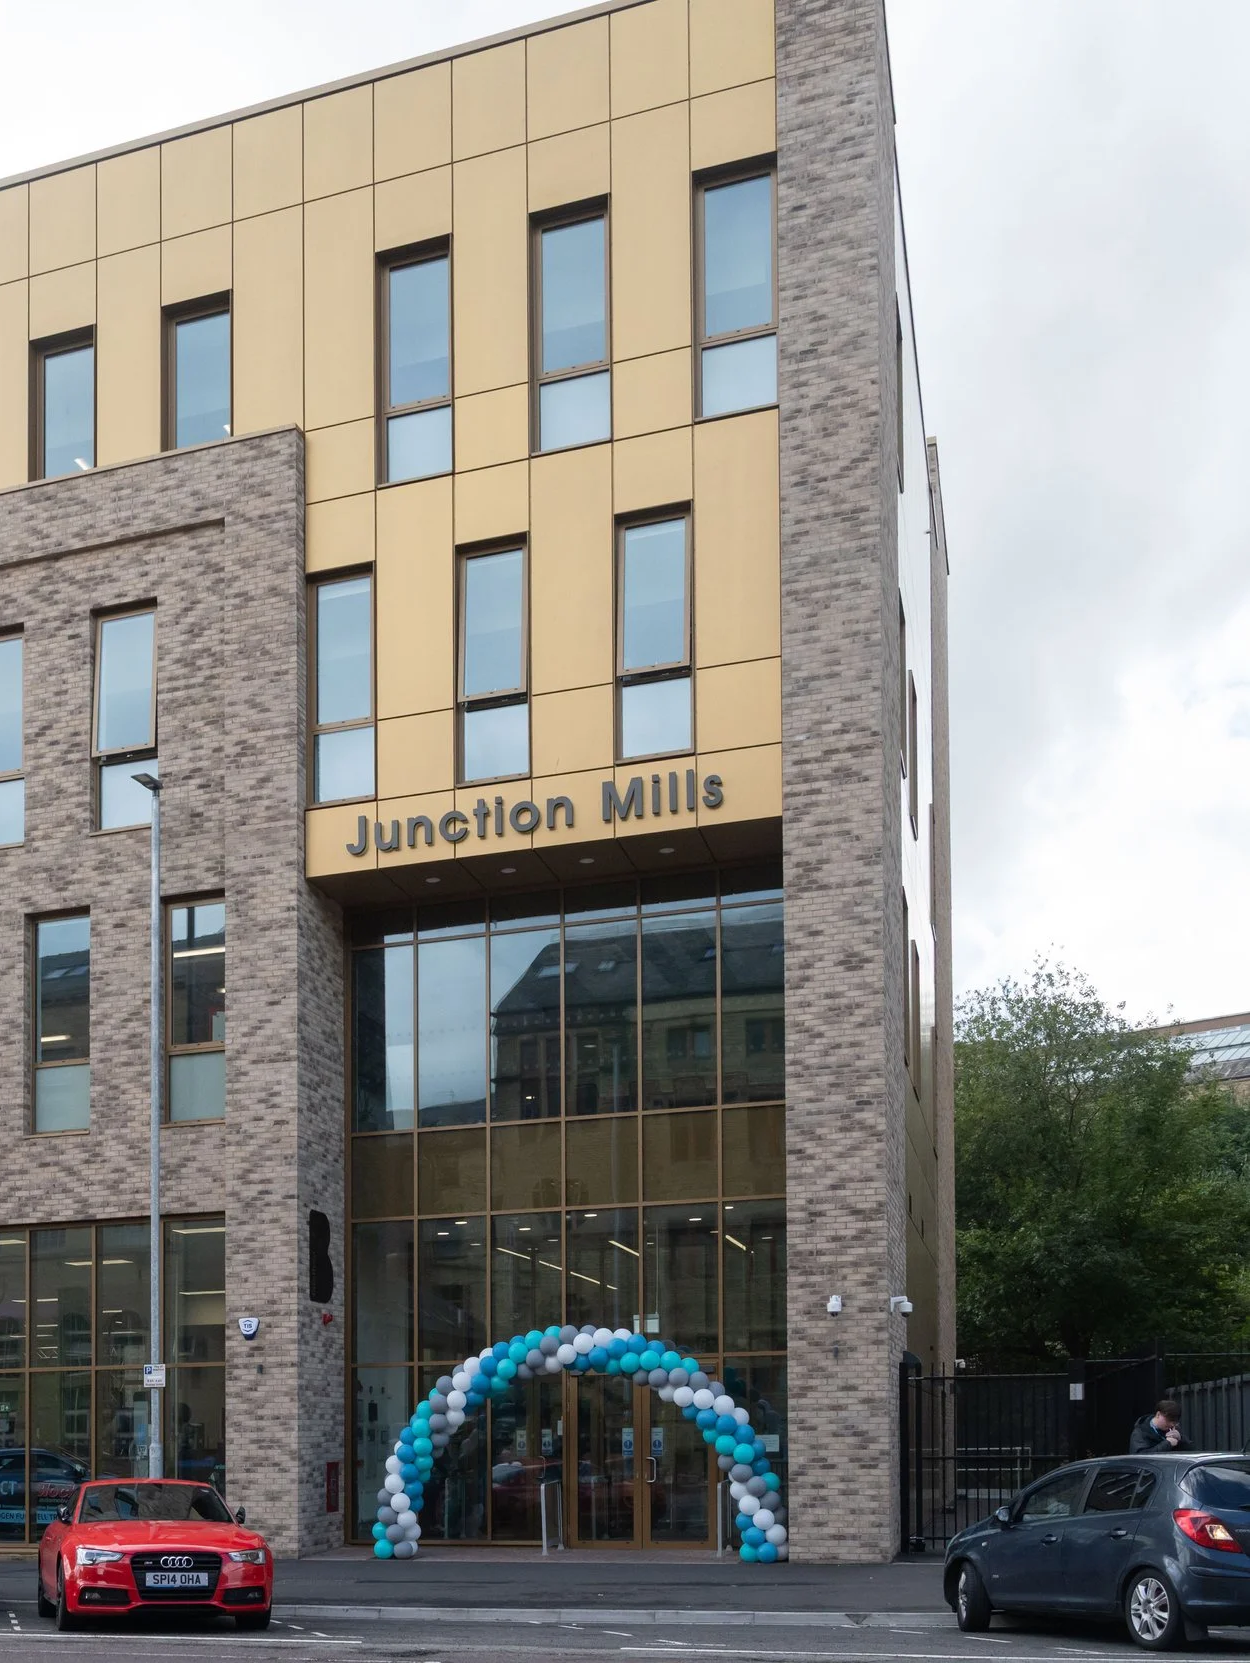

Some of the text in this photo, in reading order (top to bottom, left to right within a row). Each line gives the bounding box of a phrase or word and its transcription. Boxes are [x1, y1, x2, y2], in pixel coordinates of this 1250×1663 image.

[346, 769, 724, 856] Junction Mills
[152, 1574, 201, 1585] SP14 OHA
